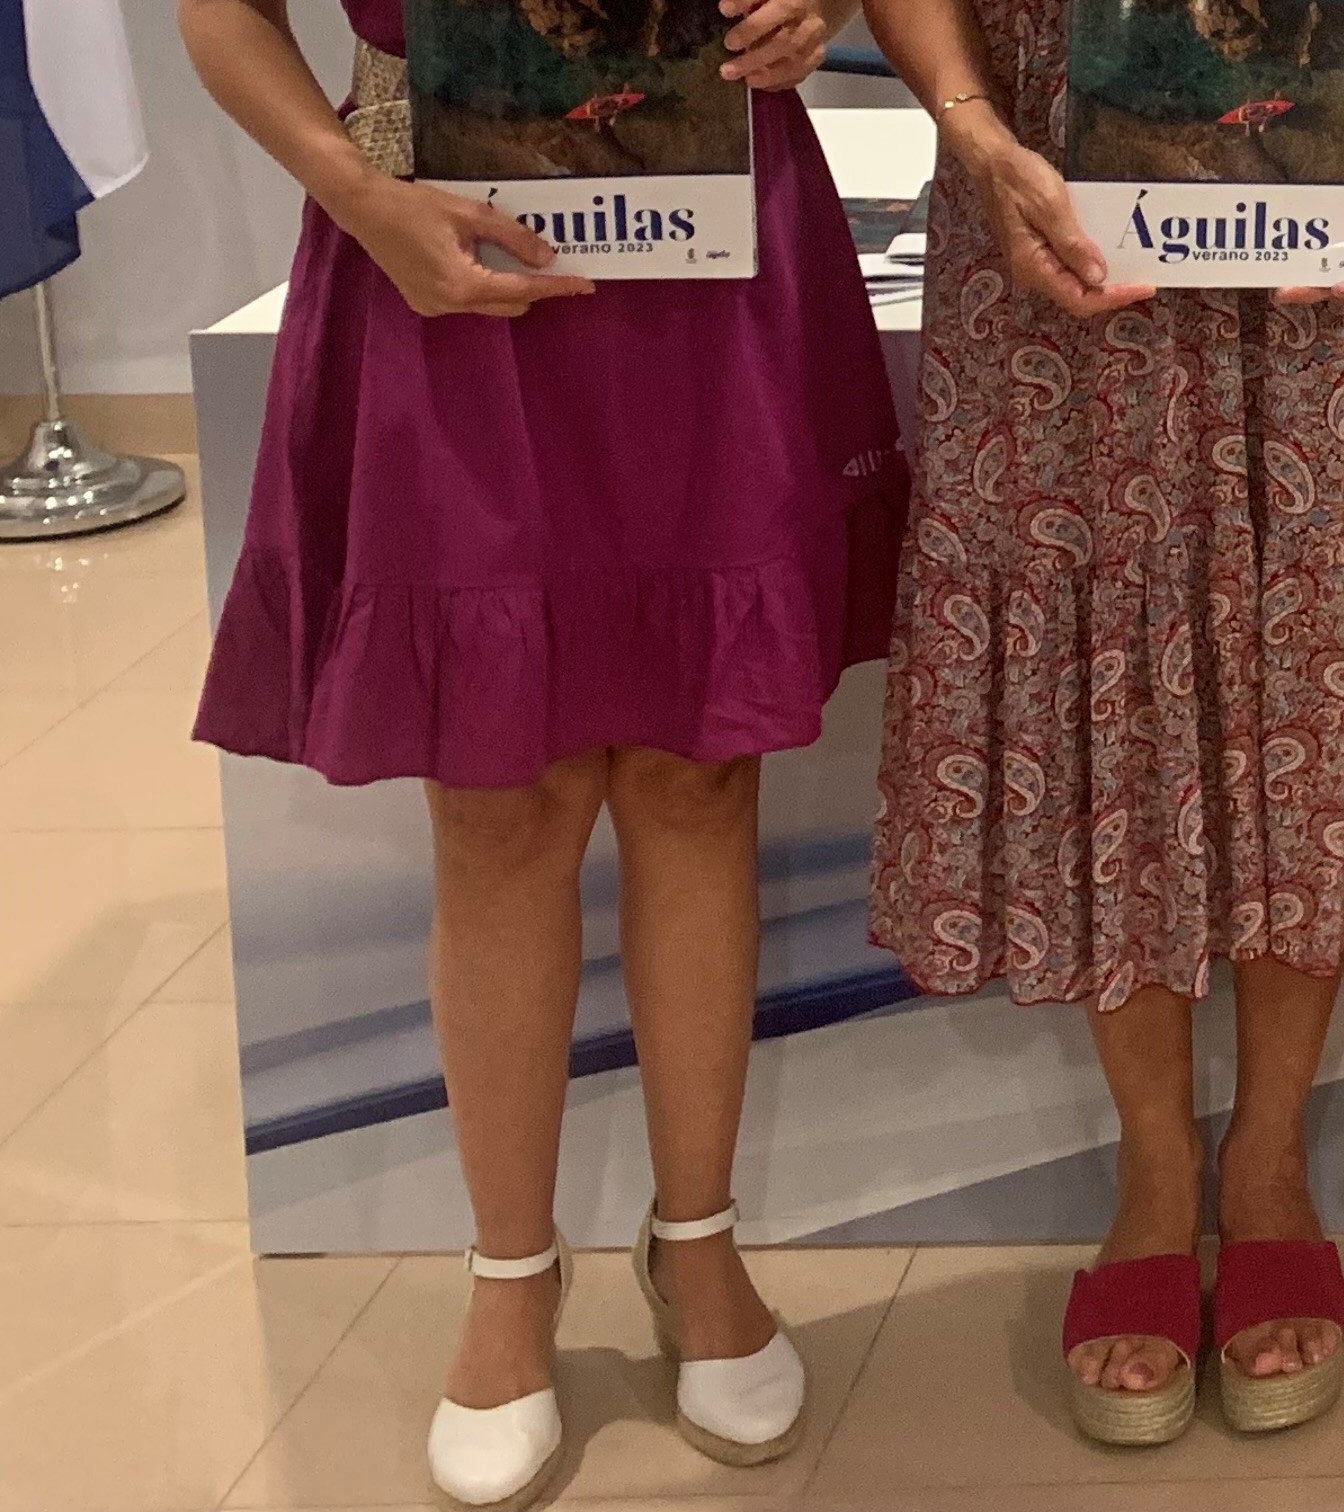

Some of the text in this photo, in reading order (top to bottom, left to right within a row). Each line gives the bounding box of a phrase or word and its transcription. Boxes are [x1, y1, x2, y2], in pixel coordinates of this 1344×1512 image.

[1116, 188, 1330, 265] Águilas
[617, 242, 654, 254] 2023
[1191, 250, 1289, 262] verano 2023
